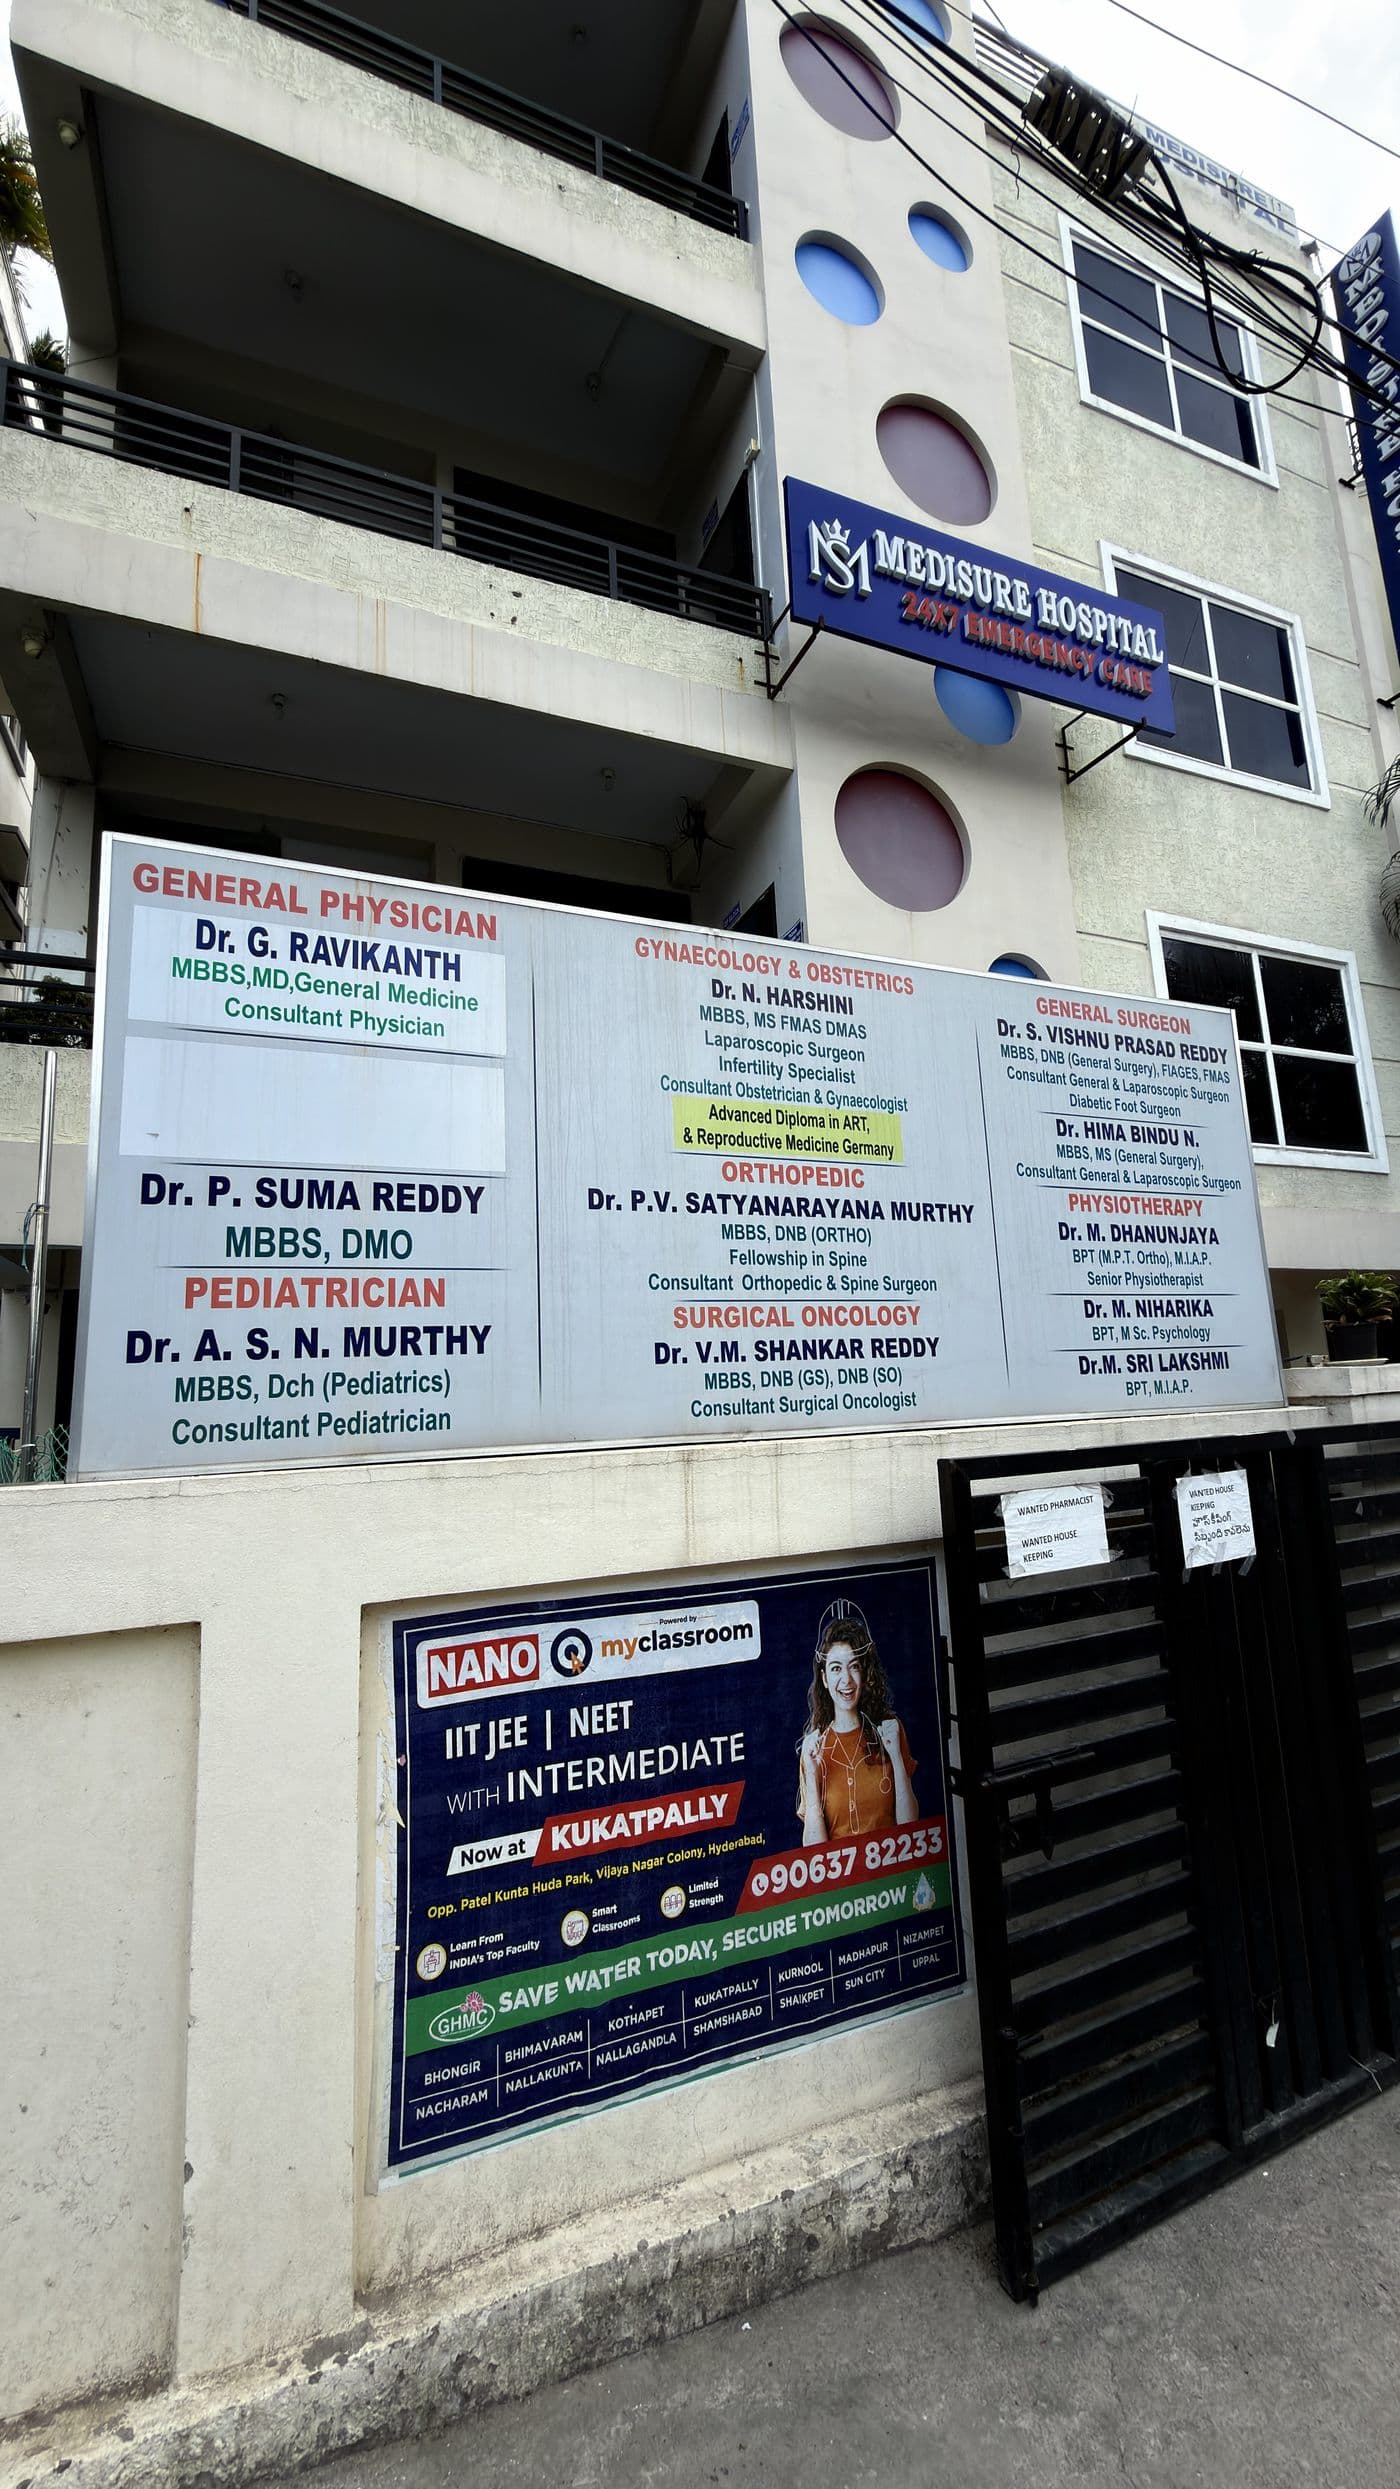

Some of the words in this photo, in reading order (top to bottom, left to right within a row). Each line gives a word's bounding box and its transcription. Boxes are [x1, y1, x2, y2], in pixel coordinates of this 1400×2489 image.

[872, 528, 1032, 622] MEDISURE
[1036, 587, 1164, 668] HOSPITAL
[901, 591, 959, 632] 24X7
[963, 613, 1095, 679] EMERGENCY
[1099, 658, 1154, 698] CARE
[133, 863, 308, 915] GENERAL
[320, 889, 497, 941] PHYSICIAN
[196, 918, 235, 954] Dr.
[247, 926, 277, 959] G.
[290, 931, 461, 982] RAVIKANTH
[635, 937, 782, 976] GYNAECOLOGY
[788, 960, 801, 979] &
[807, 962, 914, 995] OBSTETRICS
[388, 982, 478, 1011] Medicine
[711, 978, 736, 1000] Dr.
[742, 982, 761, 1004] N.
[767, 986, 853, 1015] HARSHINI
[1036, 997, 1113, 1024] GENERAL
[1117, 1009, 1191, 1035] SURGEON
[997, 1018, 1021, 1039] Dr.
[1026, 1022, 1042, 1041] S.
[1046, 1025, 1109, 1050] VISHNU
[1114, 1034, 1175, 1058] PRASAD
[1179, 1043, 1227, 1065] REDDY
[1000, 1043, 1038, 1064] MBBS,
[1040, 1049, 1065, 1064] DNB
[1068, 1052, 1112, 1070] (General
[1114, 1058, 1160, 1079] Surgery),
[1161, 1063, 1201, 1083] FIAGES,
[1203, 1069, 1230, 1084] FMAS
[660, 1074, 732, 1097] Consultant
[735, 1081, 810, 1103] Obstetrician
[814, 1089, 823, 1104] &
[826, 1090, 908, 1115] Gynaecologist
[1007, 1066, 1067, 1086] Consultant
[1069, 1073, 1107, 1090] General
[1112, 1077, 1120, 1091] &
[1122, 1079, 1189, 1100] Laparoscopic
[1190, 1086, 1230, 1104] Surgeon
[709, 1104, 772, 1124] Advanced
[776, 1109, 826, 1130] Diploma
[828, 1113, 840, 1129] in
[843, 1115, 870, 1135] ART,
[1056, 1118, 1079, 1138] Dr.
[1083, 1121, 1127, 1142] HIMA
[1130, 1125, 1179, 1146] BINDU
[1183, 1130, 1199, 1148] N.
[683, 1127, 693, 1144] &
[697, 1128, 782, 1150] Reproductive
[785, 1134, 839, 1153] Medicine
[842, 1138, 894, 1161] Germany
[722, 1161, 865, 1188] ORTHOPEDIC
[588, 1188, 622, 1211] Dr.
[631, 1190, 677, 1213] P.V.
[686, 1192, 885, 1220] SATYANARAYANA
[890, 1201, 974, 1223] MURTHY
[1068, 1193, 1203, 1217] PHYSIOTHERAPY
[1058, 1222, 1082, 1241] Dr.
[1086, 1223, 1106, 1242] M.
[1110, 1224, 1220, 1245] DHANUNJAYA
[1072, 1249, 1095, 1263] BPT
[1098, 1249, 1135, 1267] (M.P.T.
[1137, 1250, 1172, 1268] Ortho),
[1174, 1251, 1211, 1265] M.I.A.P.
[185, 1277, 445, 1309] PEDIATRICIAN
[1087, 1271, 1122, 1286] Senior
[1124, 1272, 1204, 1290] Physiotherapist
[673, 1306, 795, 1329] SURGICAL
[801, 1305, 921, 1327] ONCOLOGY
[126, 1330, 180, 1364] Dr.
[193, 1329, 231, 1362] A.
[246, 1328, 280, 1360] S.
[294, 1327, 329, 1359] N.
[344, 1325, 492, 1358] MURTHY
[654, 1342, 688, 1365] Dr.
[695, 1341, 746, 1363] V.M.
[754, 1338, 865, 1362] SHANKAR
[870, 1337, 939, 1359] REDDY
[1126, 1354, 1154, 1373] SRI
[1158, 1351, 1229, 1372] LAKSHMI
[1017, 1503, 1049, 1516] WANTED
[1050, 1495, 1093, 1510] PHARMACIST
[1189, 1488, 1215, 1498] WANTED
[1215, 1484, 1235, 1494] HOUSE
[1190, 1501, 1215, 1511] KEEPING
[1021, 1535, 1053, 1548] WANTED
[1054, 1529, 1078, 1542] HOUSE
[1023, 1549, 1053, 1563] KEEPING
[659, 1615, 688, 1625] Powered
[689, 1615, 697, 1623] by
[602, 1623, 753, 1660] myclassroom
[430, 1641, 537, 1691] NANO
[446, 1723, 481, 1759] IIT
[485, 1715, 527, 1761] JEE
[570, 1700, 633, 1738] NEET
[447, 1786, 499, 1814] WITH
[508, 1732, 745, 1802] INTERMEDIATE
[461, 1845, 503, 1867] Now
[508, 1838, 526, 1856] at
[552, 1793, 728, 1851] KUKATPALLY
[428, 1904, 457, 1918] Opp.
[461, 1892, 491, 1911] Patel
[495, 1886, 529, 1903] Kunta
[532, 1878, 562, 1894] Huda
[566, 1872, 593, 1886] Park,
[596, 1865, 629, 1879] Vijaya
[632, 1857, 664, 1872] Nagar
[667, 1848, 706, 1864] Colony,
[708, 1833, 765, 1855] Hyderabad,
[770, 1846, 857, 1894] 90637
[865, 1827, 942, 1870] 82233
[689, 1879, 719, 1893] Limited
[689, 1894, 724, 1908] Strength
[592, 1904, 617, 1917] Smart
[592, 1915, 641, 1933] Classrooms
[450, 1939, 477, 1953] Learn
[479, 1933, 503, 1946] From
[486, 1950, 504, 1960] Top
[506, 1940, 540, 1956] Faculty
[499, 1981, 558, 2013] SAVE
[565, 1956, 641, 1994] WATER
[646, 1938, 717, 1971] TODAY,
[722, 1914, 797, 1951] SECURE
[800, 1885, 907, 1931] TOMORROW
[903, 1925, 944, 1945] NIZAMPET
[838, 1942, 888, 1966] MADHAPUR
[912, 1953, 940, 1968] UPPAL
[778, 1962, 824, 1983] KURNOOL
[845, 1976, 863, 1990] SUN
[865, 1968, 885, 1983] CITY
[694, 1978, 759, 2008] KUKATPALLY
[780, 1988, 824, 2008] SHAIKPET
[438, 2009, 488, 2035] GHMC
[608, 2005, 664, 2032] KOTHAPET
[694, 2005, 762, 2036] SHAMSHABAD
[505, 2030, 583, 2063] BHIMAVARAM
[596, 2032, 677, 2066] NALLAGANDLA
[424, 2060, 480, 2086] BHONGIR
[506, 2061, 583, 2093] NALLAKUNTA
[416, 2089, 488, 2120] NACHARAM
